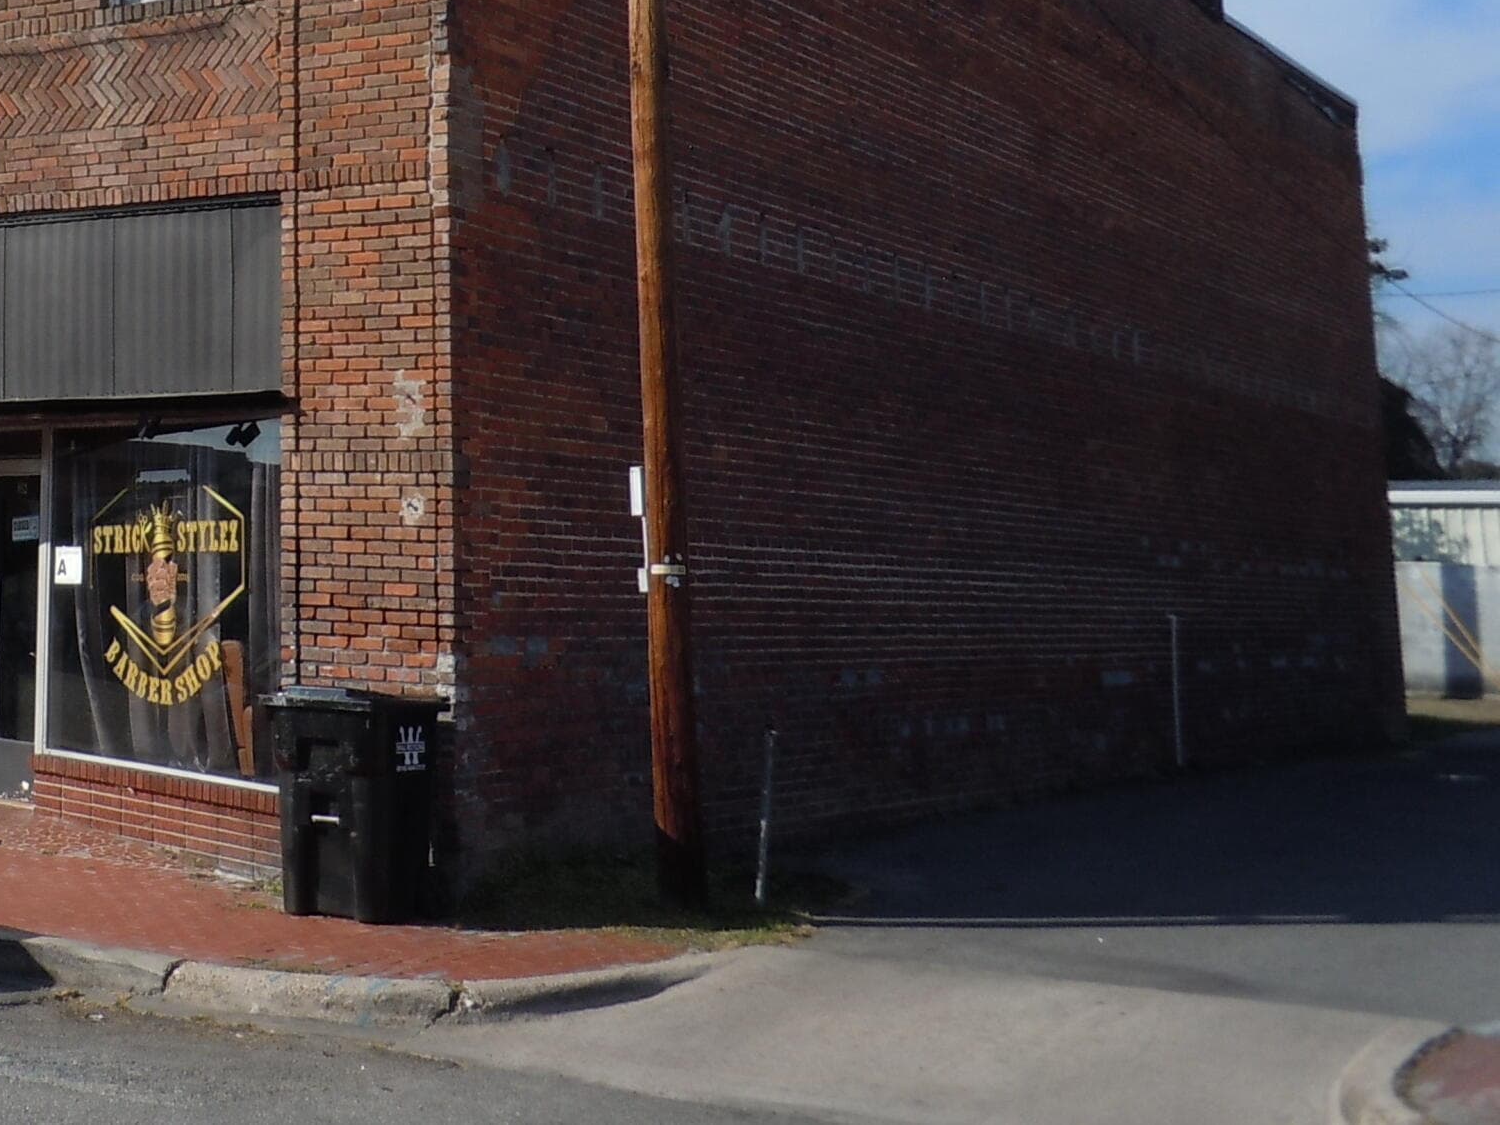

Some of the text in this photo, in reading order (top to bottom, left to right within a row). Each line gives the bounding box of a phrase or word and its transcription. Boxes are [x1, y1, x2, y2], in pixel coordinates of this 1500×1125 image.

[93, 518, 240, 554] STRICK STYLEZ
[57, 558, 67, 576] A
[104, 636, 222, 705] BARBER SHOP
